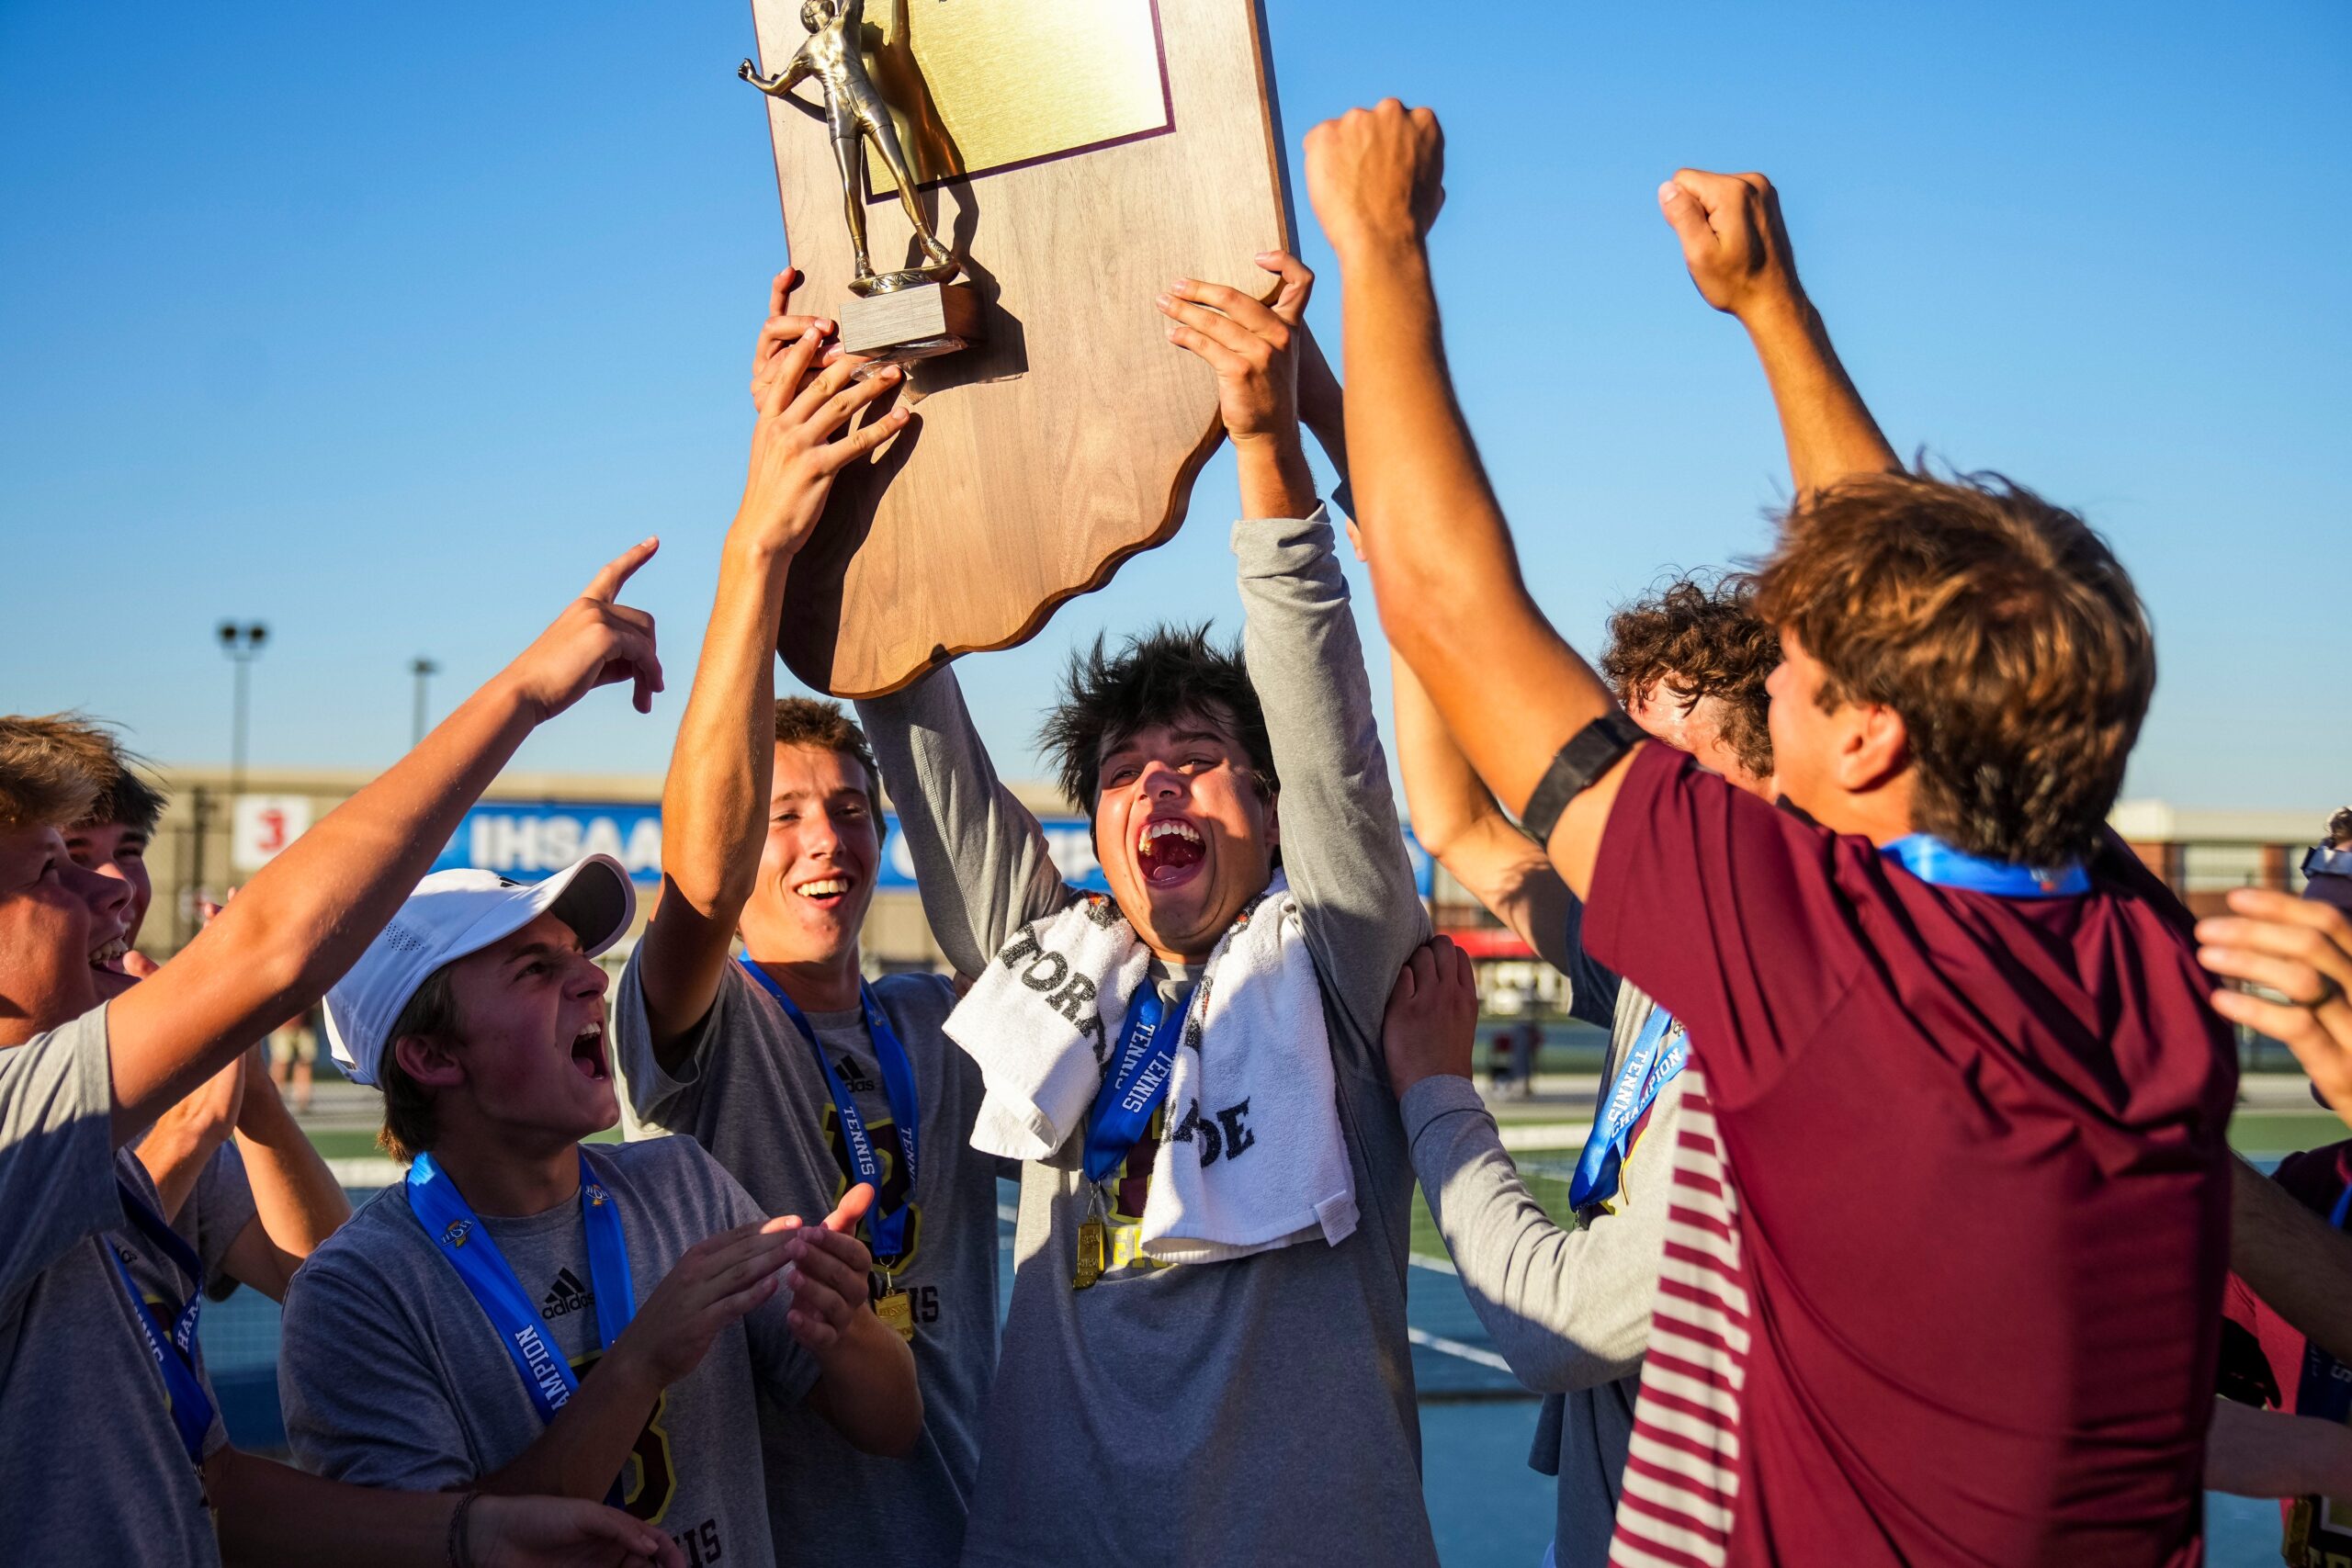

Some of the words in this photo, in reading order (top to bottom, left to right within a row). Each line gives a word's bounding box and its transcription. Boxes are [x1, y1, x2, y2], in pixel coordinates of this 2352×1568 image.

[256, 808, 286, 852] 3
[470, 814, 662, 873] IHSAA
[1122, 1050, 1176, 1113] TENNIS
[1607, 1050, 1649, 1122] TENNIS
[1611, 1047, 1683, 1139] CHAMPION
[843, 1106, 876, 1177] TENNIS
[541, 1292, 596, 1320] adidas
[514, 1324, 571, 1411] AMPION
